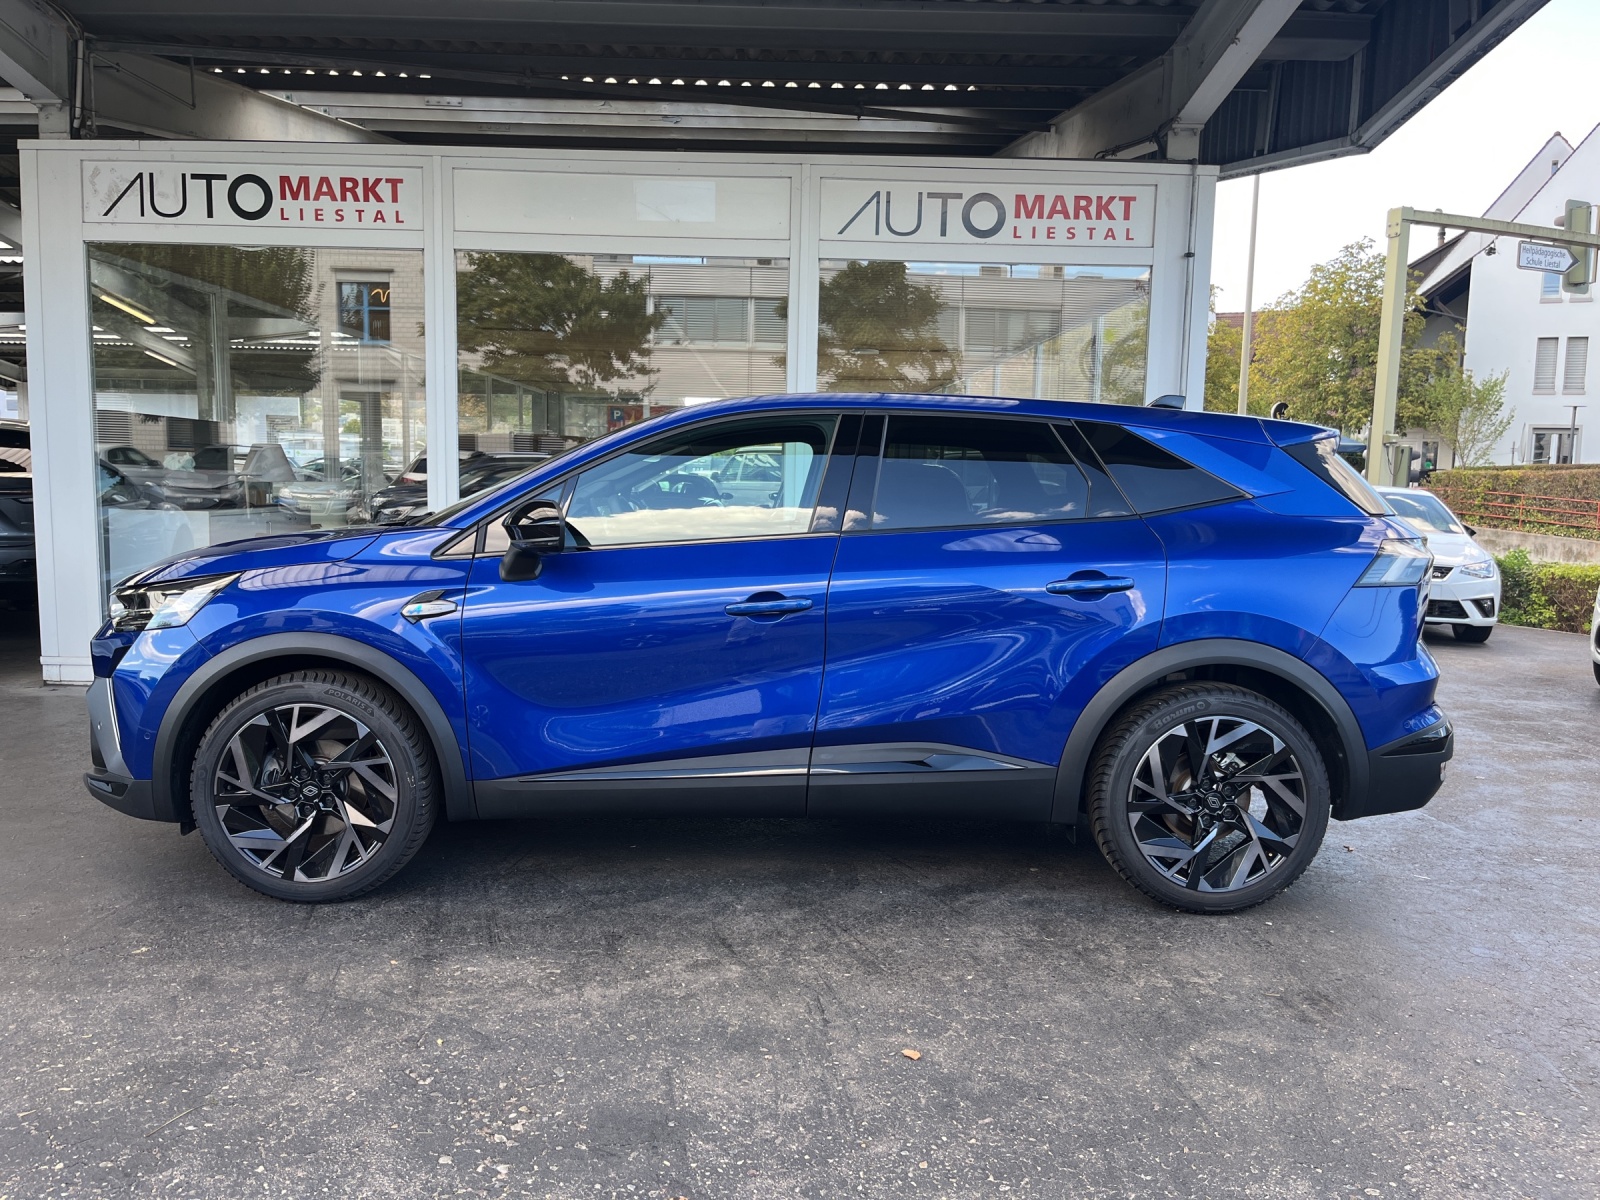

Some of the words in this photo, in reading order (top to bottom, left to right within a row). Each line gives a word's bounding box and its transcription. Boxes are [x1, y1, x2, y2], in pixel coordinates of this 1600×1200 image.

[102, 172, 274, 221] AUTO
[278, 175, 404, 204] MARKT
[280, 207, 405, 224] LIESTAL
[837, 190, 1007, 239] AUTO
[1014, 194, 1137, 221] MARKT
[1013, 225, 1135, 241] LIESTAL
[1522, 245, 1566, 259] Heilpädagogische
[1526, 257, 1543, 267] Schule
[1544, 259, 1561, 269] Liestal
[613, 410, 621, 420] P
[328, 689, 366, 709] POLARIS
[1153, 705, 1196, 730] Barum
